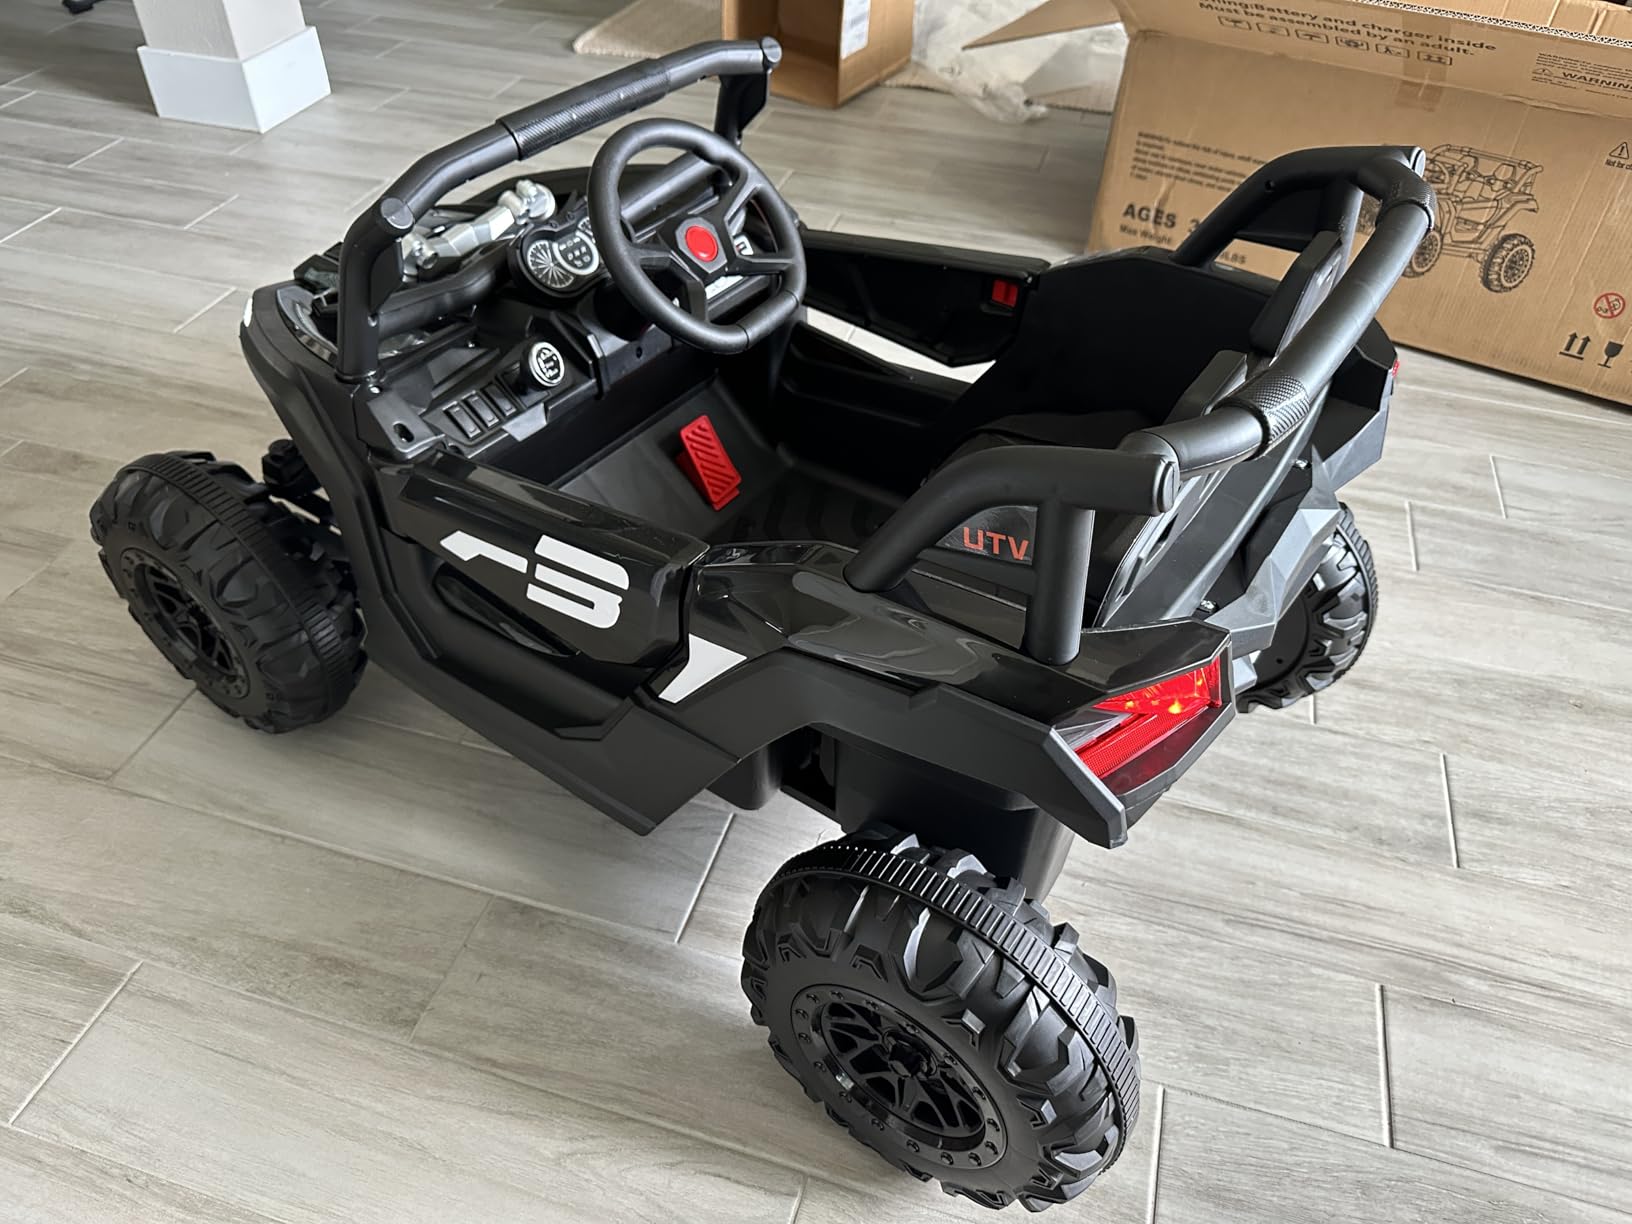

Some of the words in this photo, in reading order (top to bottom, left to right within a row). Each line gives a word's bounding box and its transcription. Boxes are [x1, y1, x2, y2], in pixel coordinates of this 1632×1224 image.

[1199, 2, 1241, 15] Must
[1244, 10, 1265, 18] be
[1269, 14, 1362, 36] assembled
[1366, 29, 1388, 41] by
[1393, 36, 1415, 45] an
[1419, 39, 1476, 56] adult.
[1323, 12, 1357, 27] and
[1361, 21, 1435, 40] charger
[1438, 34, 1497, 51] inside
[1122, 203, 1177, 229] AGES
[963, 526, 1029, 561] UTV
